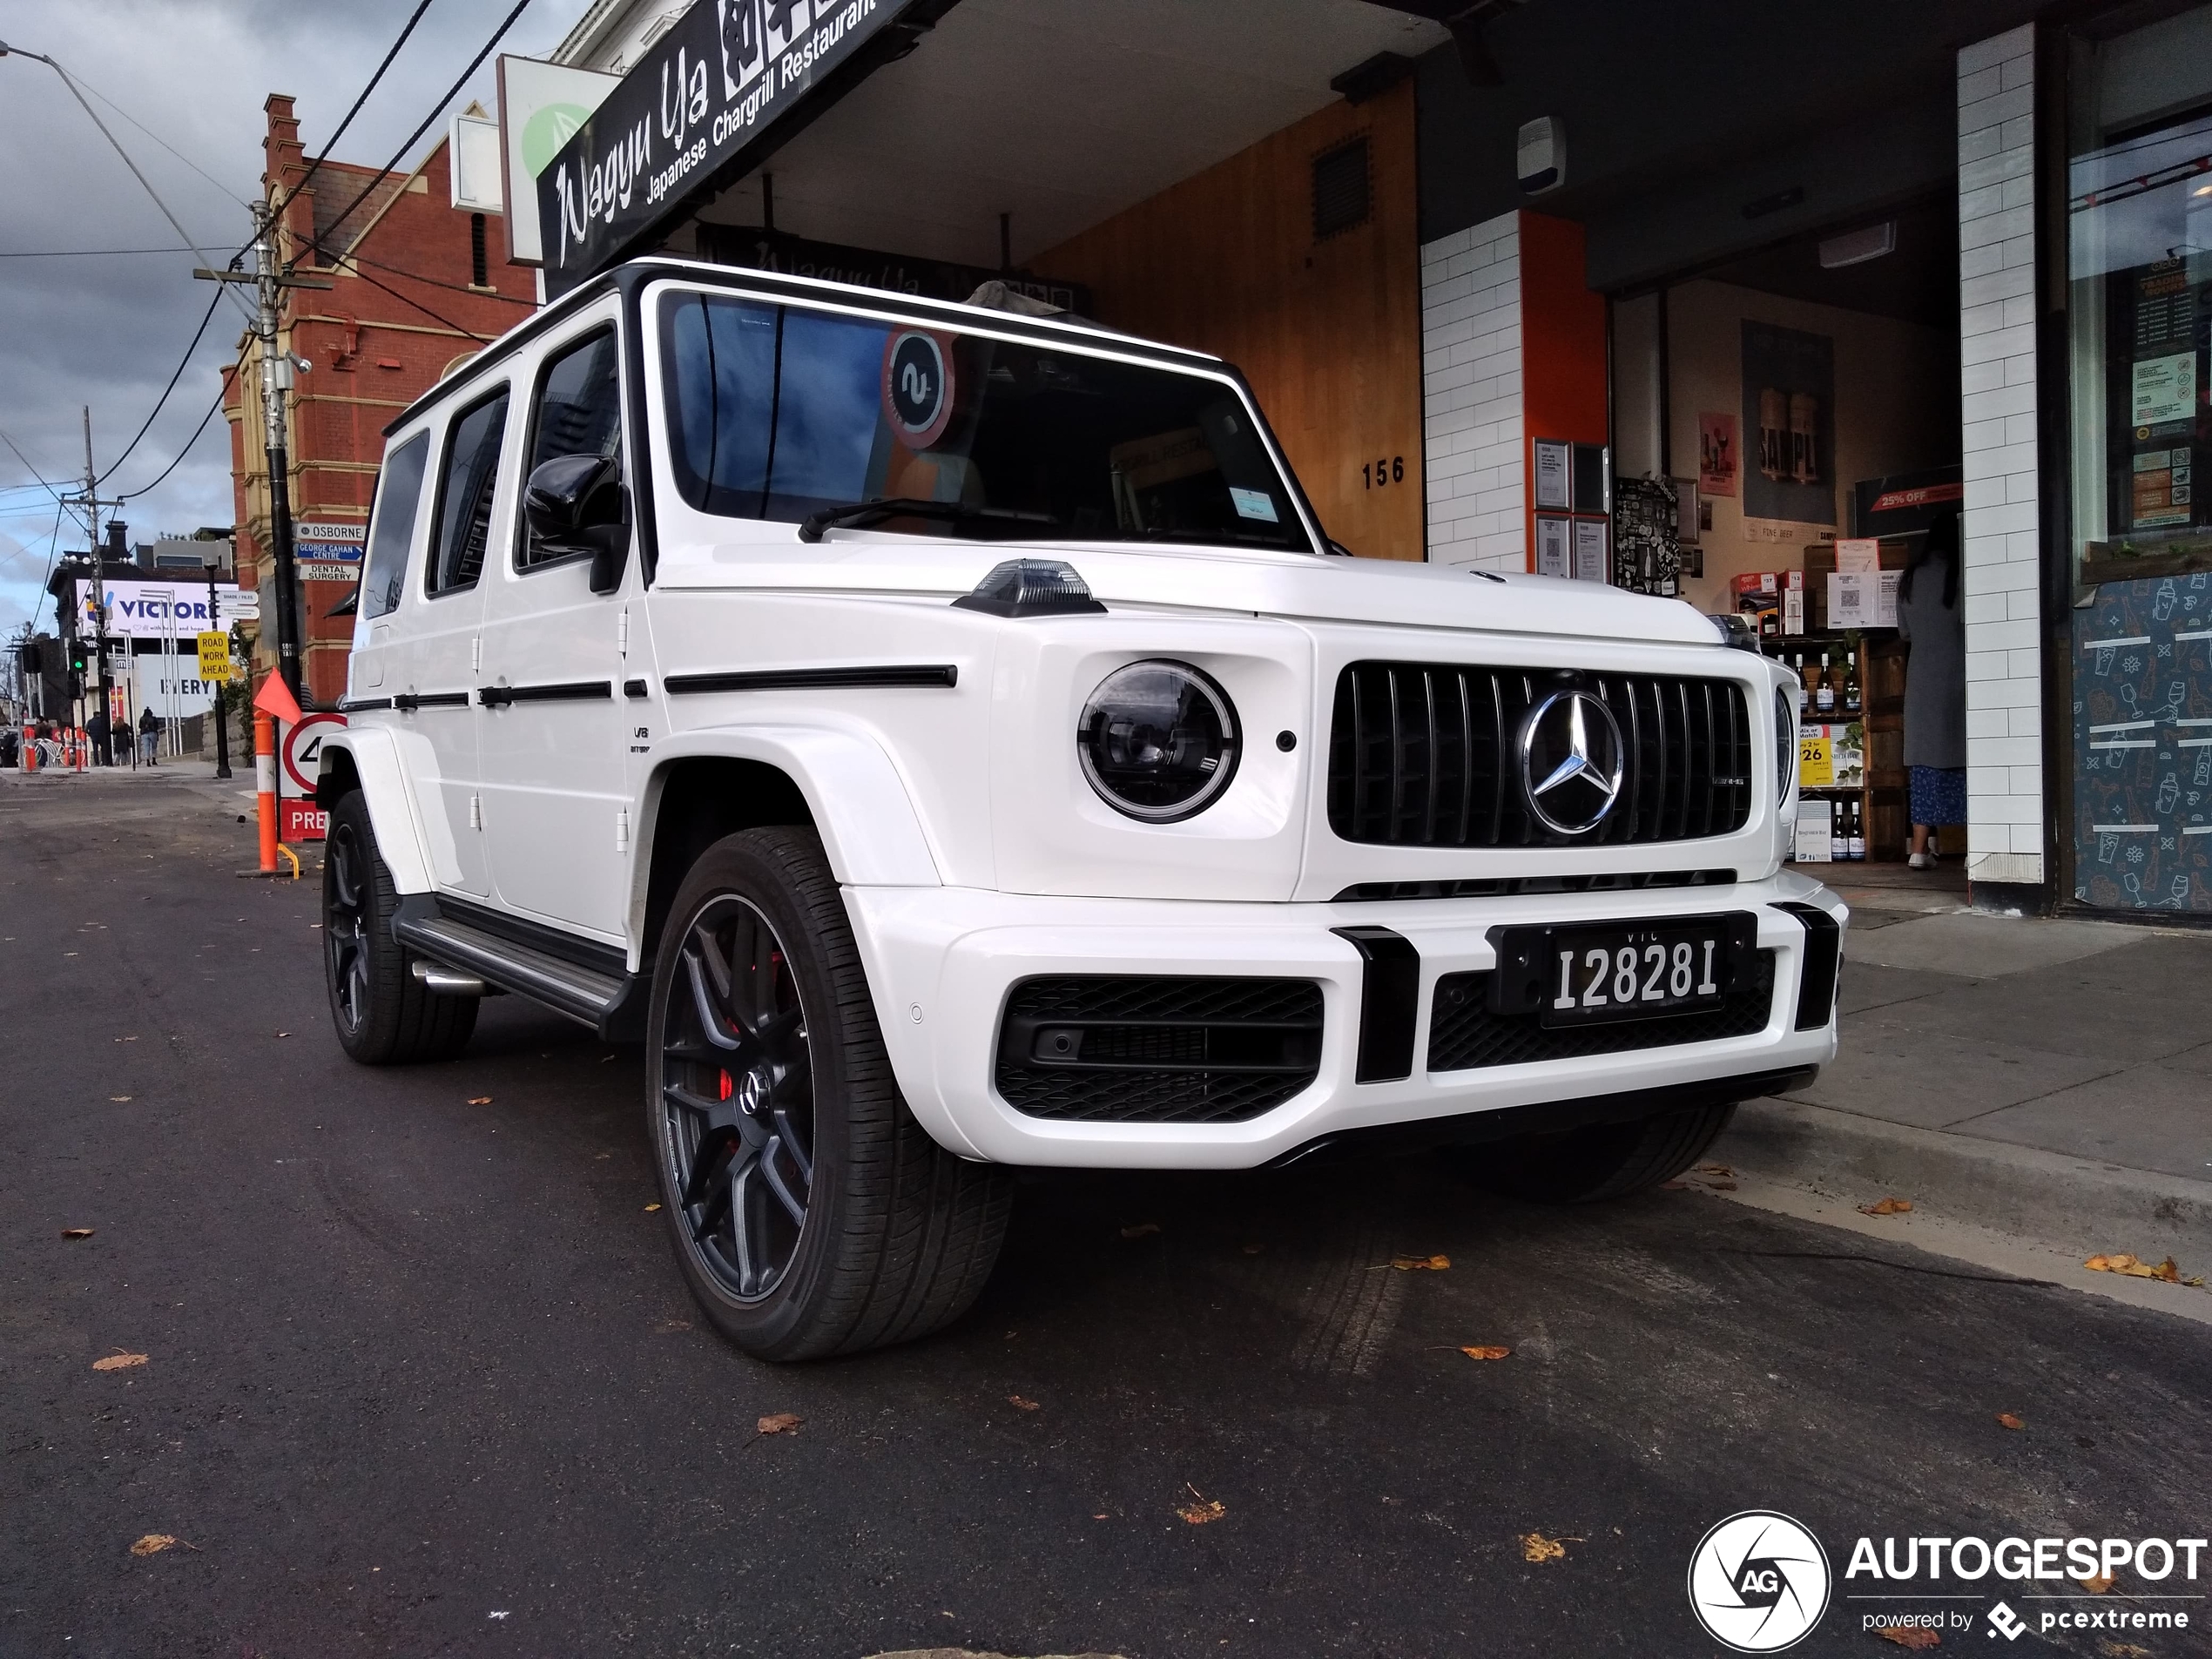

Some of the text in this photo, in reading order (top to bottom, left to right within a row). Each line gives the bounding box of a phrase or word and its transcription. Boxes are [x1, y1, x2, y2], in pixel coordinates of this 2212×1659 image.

[646, 138, 707, 206] Japanese
[712, 67, 774, 146] Chargrill
[781, 0, 876, 90] Restaurant
[556, 45, 709, 269] Wagyu Ya
[1362, 455, 1404, 490] 156
[1882, 495, 1905, 507] 25%
[1905, 491, 1926, 502] OFF
[313, 526, 362, 538] OSBORNE
[300, 543, 327, 552] GEORGE
[313, 551, 341, 560] CENTRE
[202, 638, 224, 647] ROAD
[203, 651, 226, 660] WORK
[201, 665, 228, 674] AHEAD
[299, 736, 323, 762] 4
[1800, 748, 1823, 761] 26
[292, 812, 325, 830] PRE
